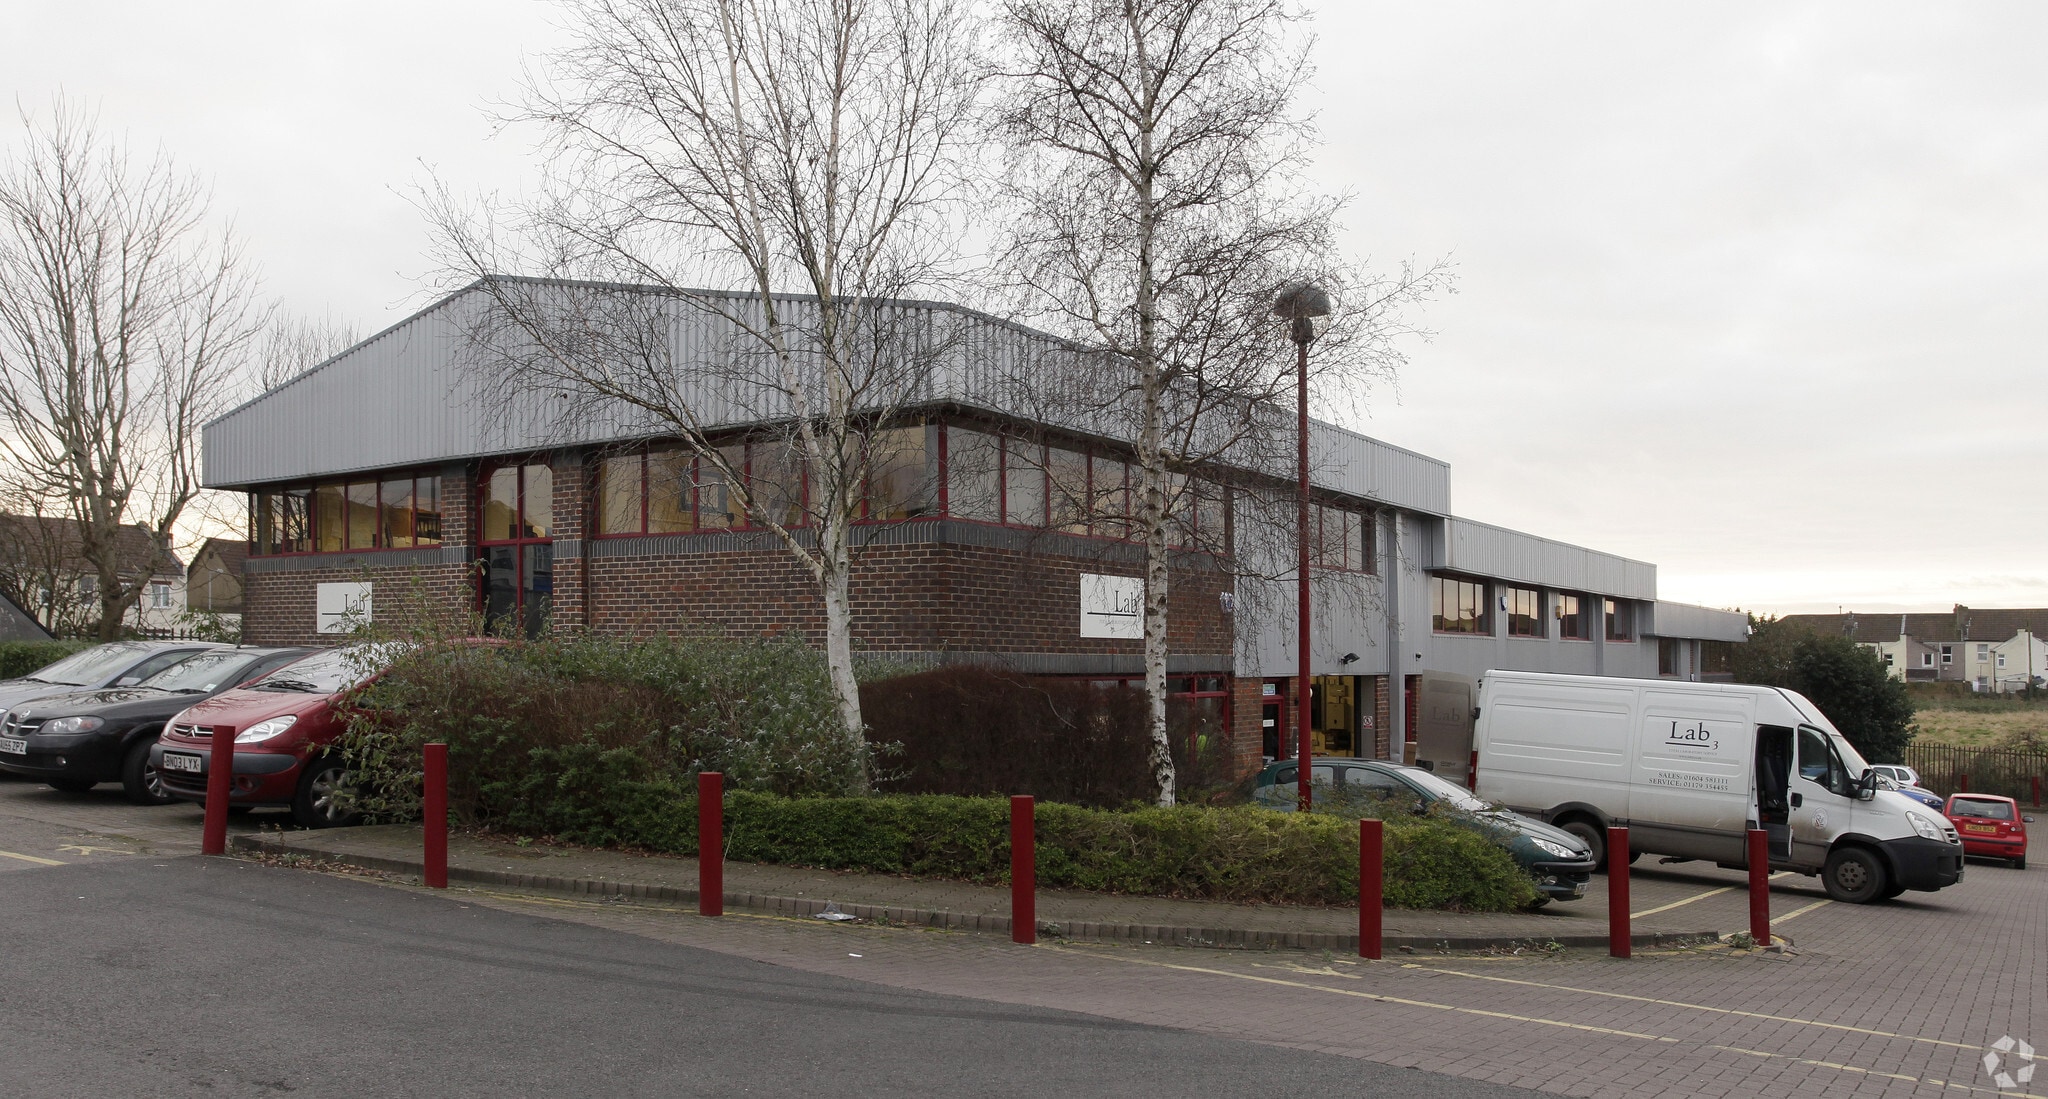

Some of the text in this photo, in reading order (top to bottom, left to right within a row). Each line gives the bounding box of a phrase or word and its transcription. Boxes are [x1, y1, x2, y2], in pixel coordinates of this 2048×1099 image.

[344, 593, 366, 612] Lab
[1114, 590, 1138, 613] Lab
[1432, 706, 1461, 721] Lab
[1669, 721, 1719, 750] Lab 3
[183, 757, 198, 770] LYX
